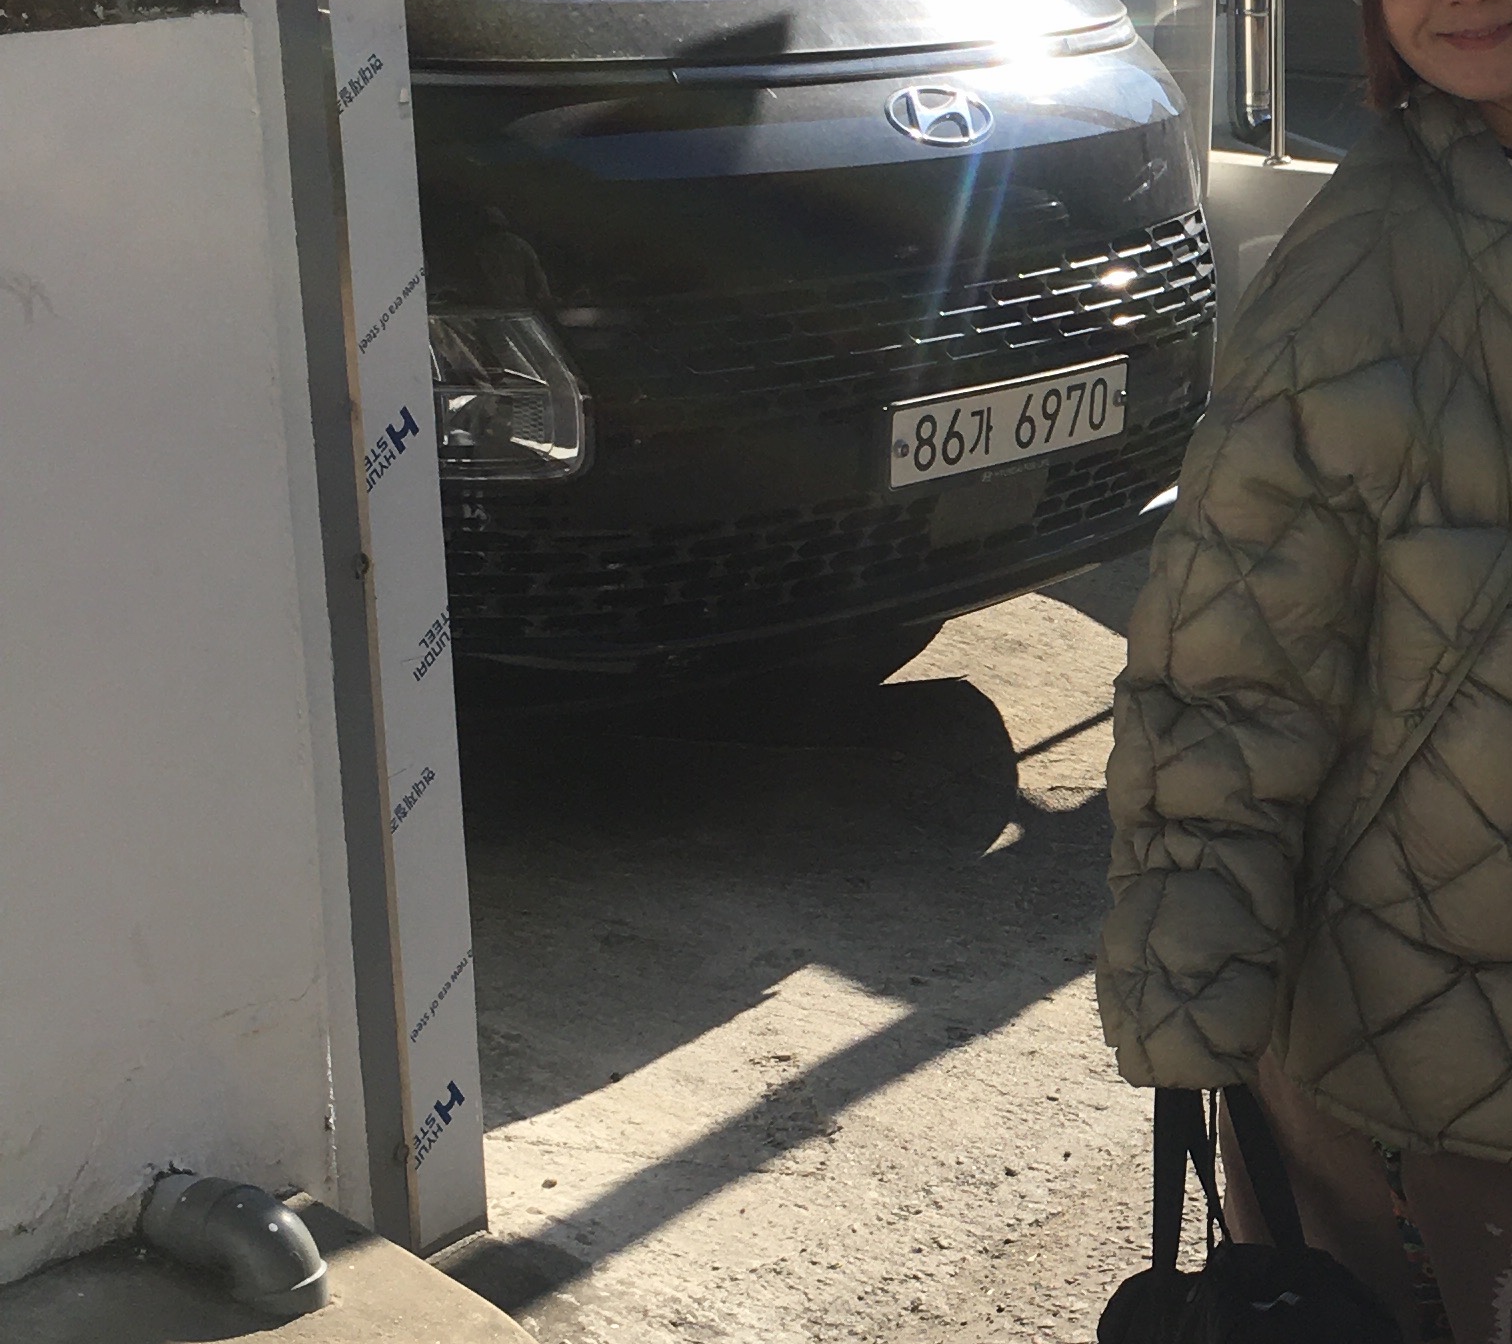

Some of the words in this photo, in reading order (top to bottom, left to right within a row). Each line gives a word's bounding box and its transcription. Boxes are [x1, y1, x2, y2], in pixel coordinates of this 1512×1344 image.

[913, 406, 993, 472] 86가
[1014, 377, 1108, 450] 6970
[419, 605, 450, 649] TEEL
